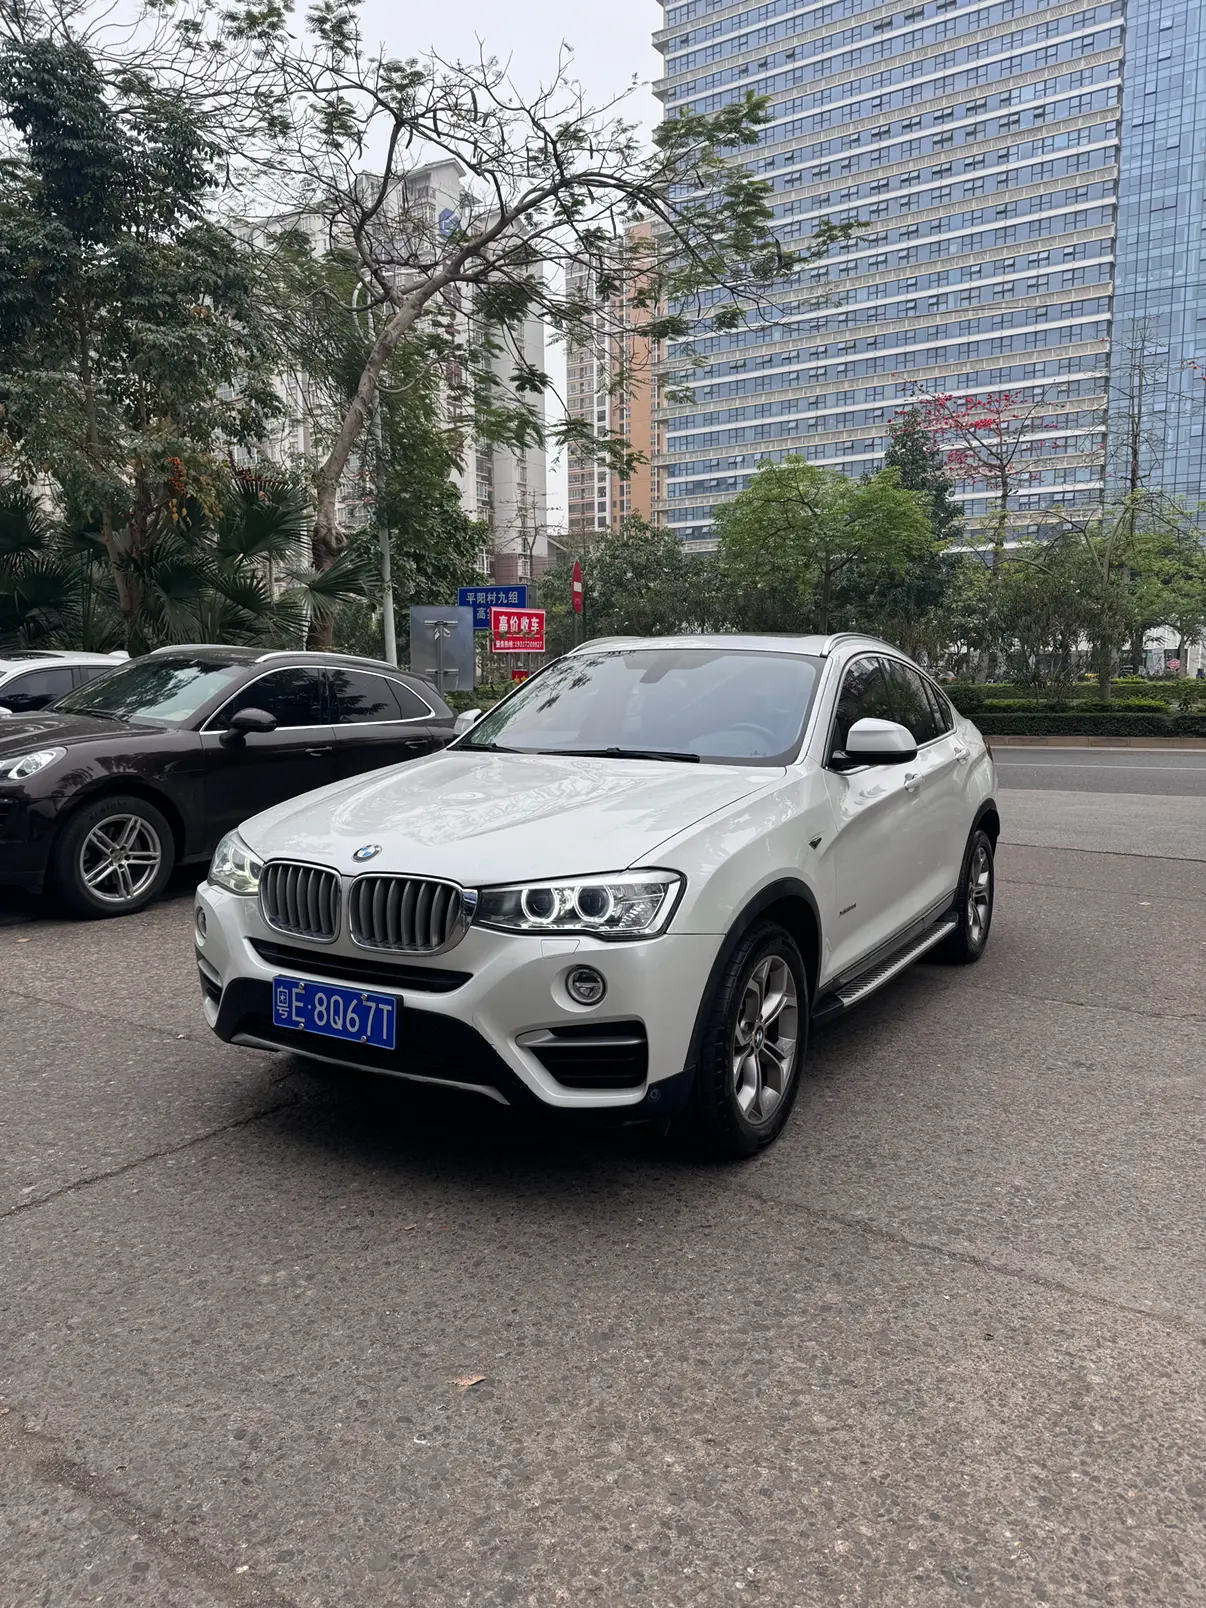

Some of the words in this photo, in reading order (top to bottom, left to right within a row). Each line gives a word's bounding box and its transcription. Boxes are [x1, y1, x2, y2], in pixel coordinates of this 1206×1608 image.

[466, 591, 518, 604] 平阳村九组
[499, 615, 539, 635] 高价收车
[277, 986, 392, 1040] 粤E·8Q67T
